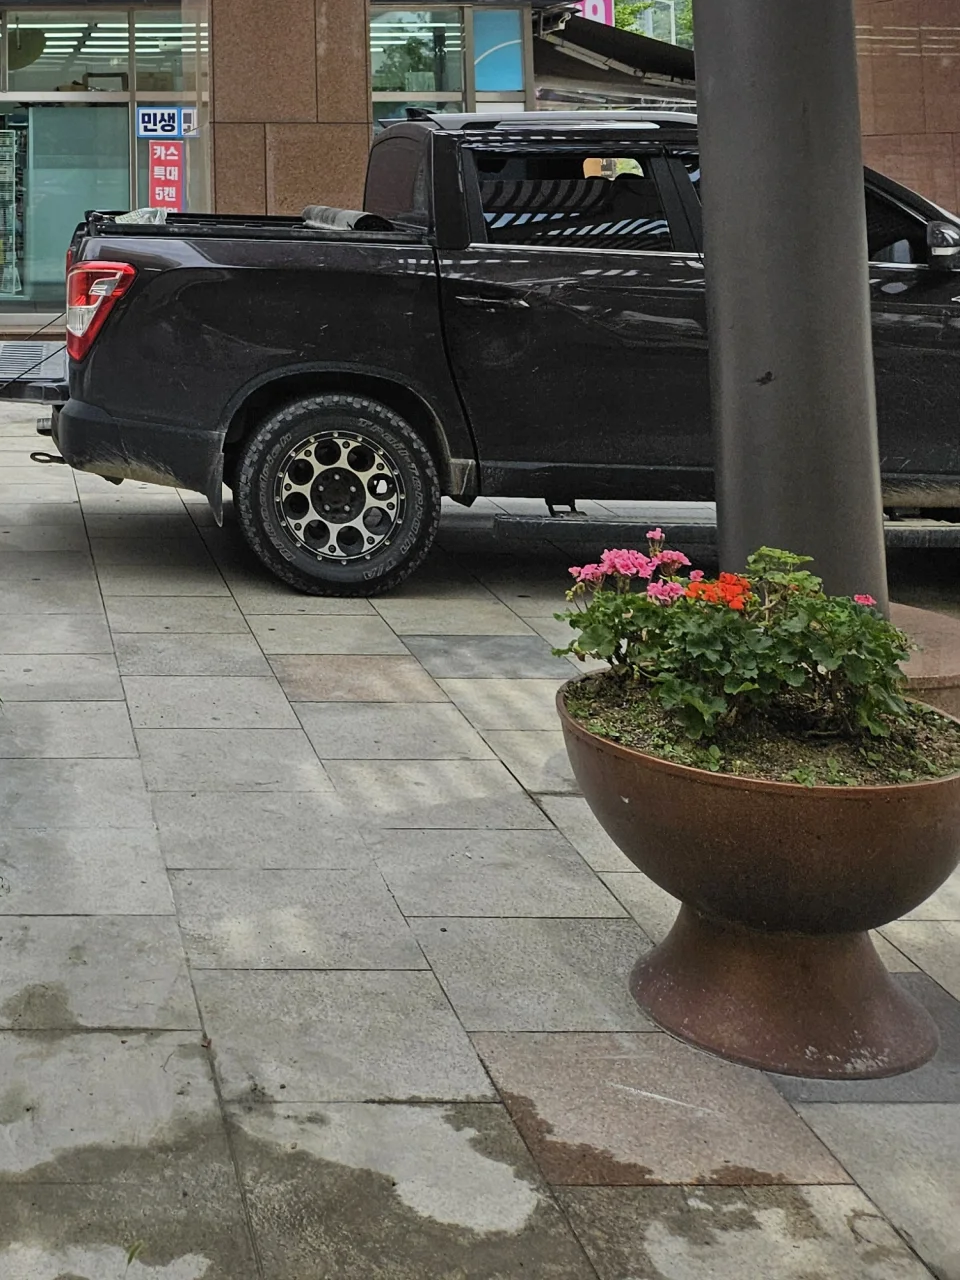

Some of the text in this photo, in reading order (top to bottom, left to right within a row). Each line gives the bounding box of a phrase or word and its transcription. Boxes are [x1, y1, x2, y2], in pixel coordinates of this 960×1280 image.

[141, 112, 176, 133] 민생
[153, 145, 179, 160] 카스
[153, 166, 179, 181] 특대
[155, 186, 177, 201] 5캔
